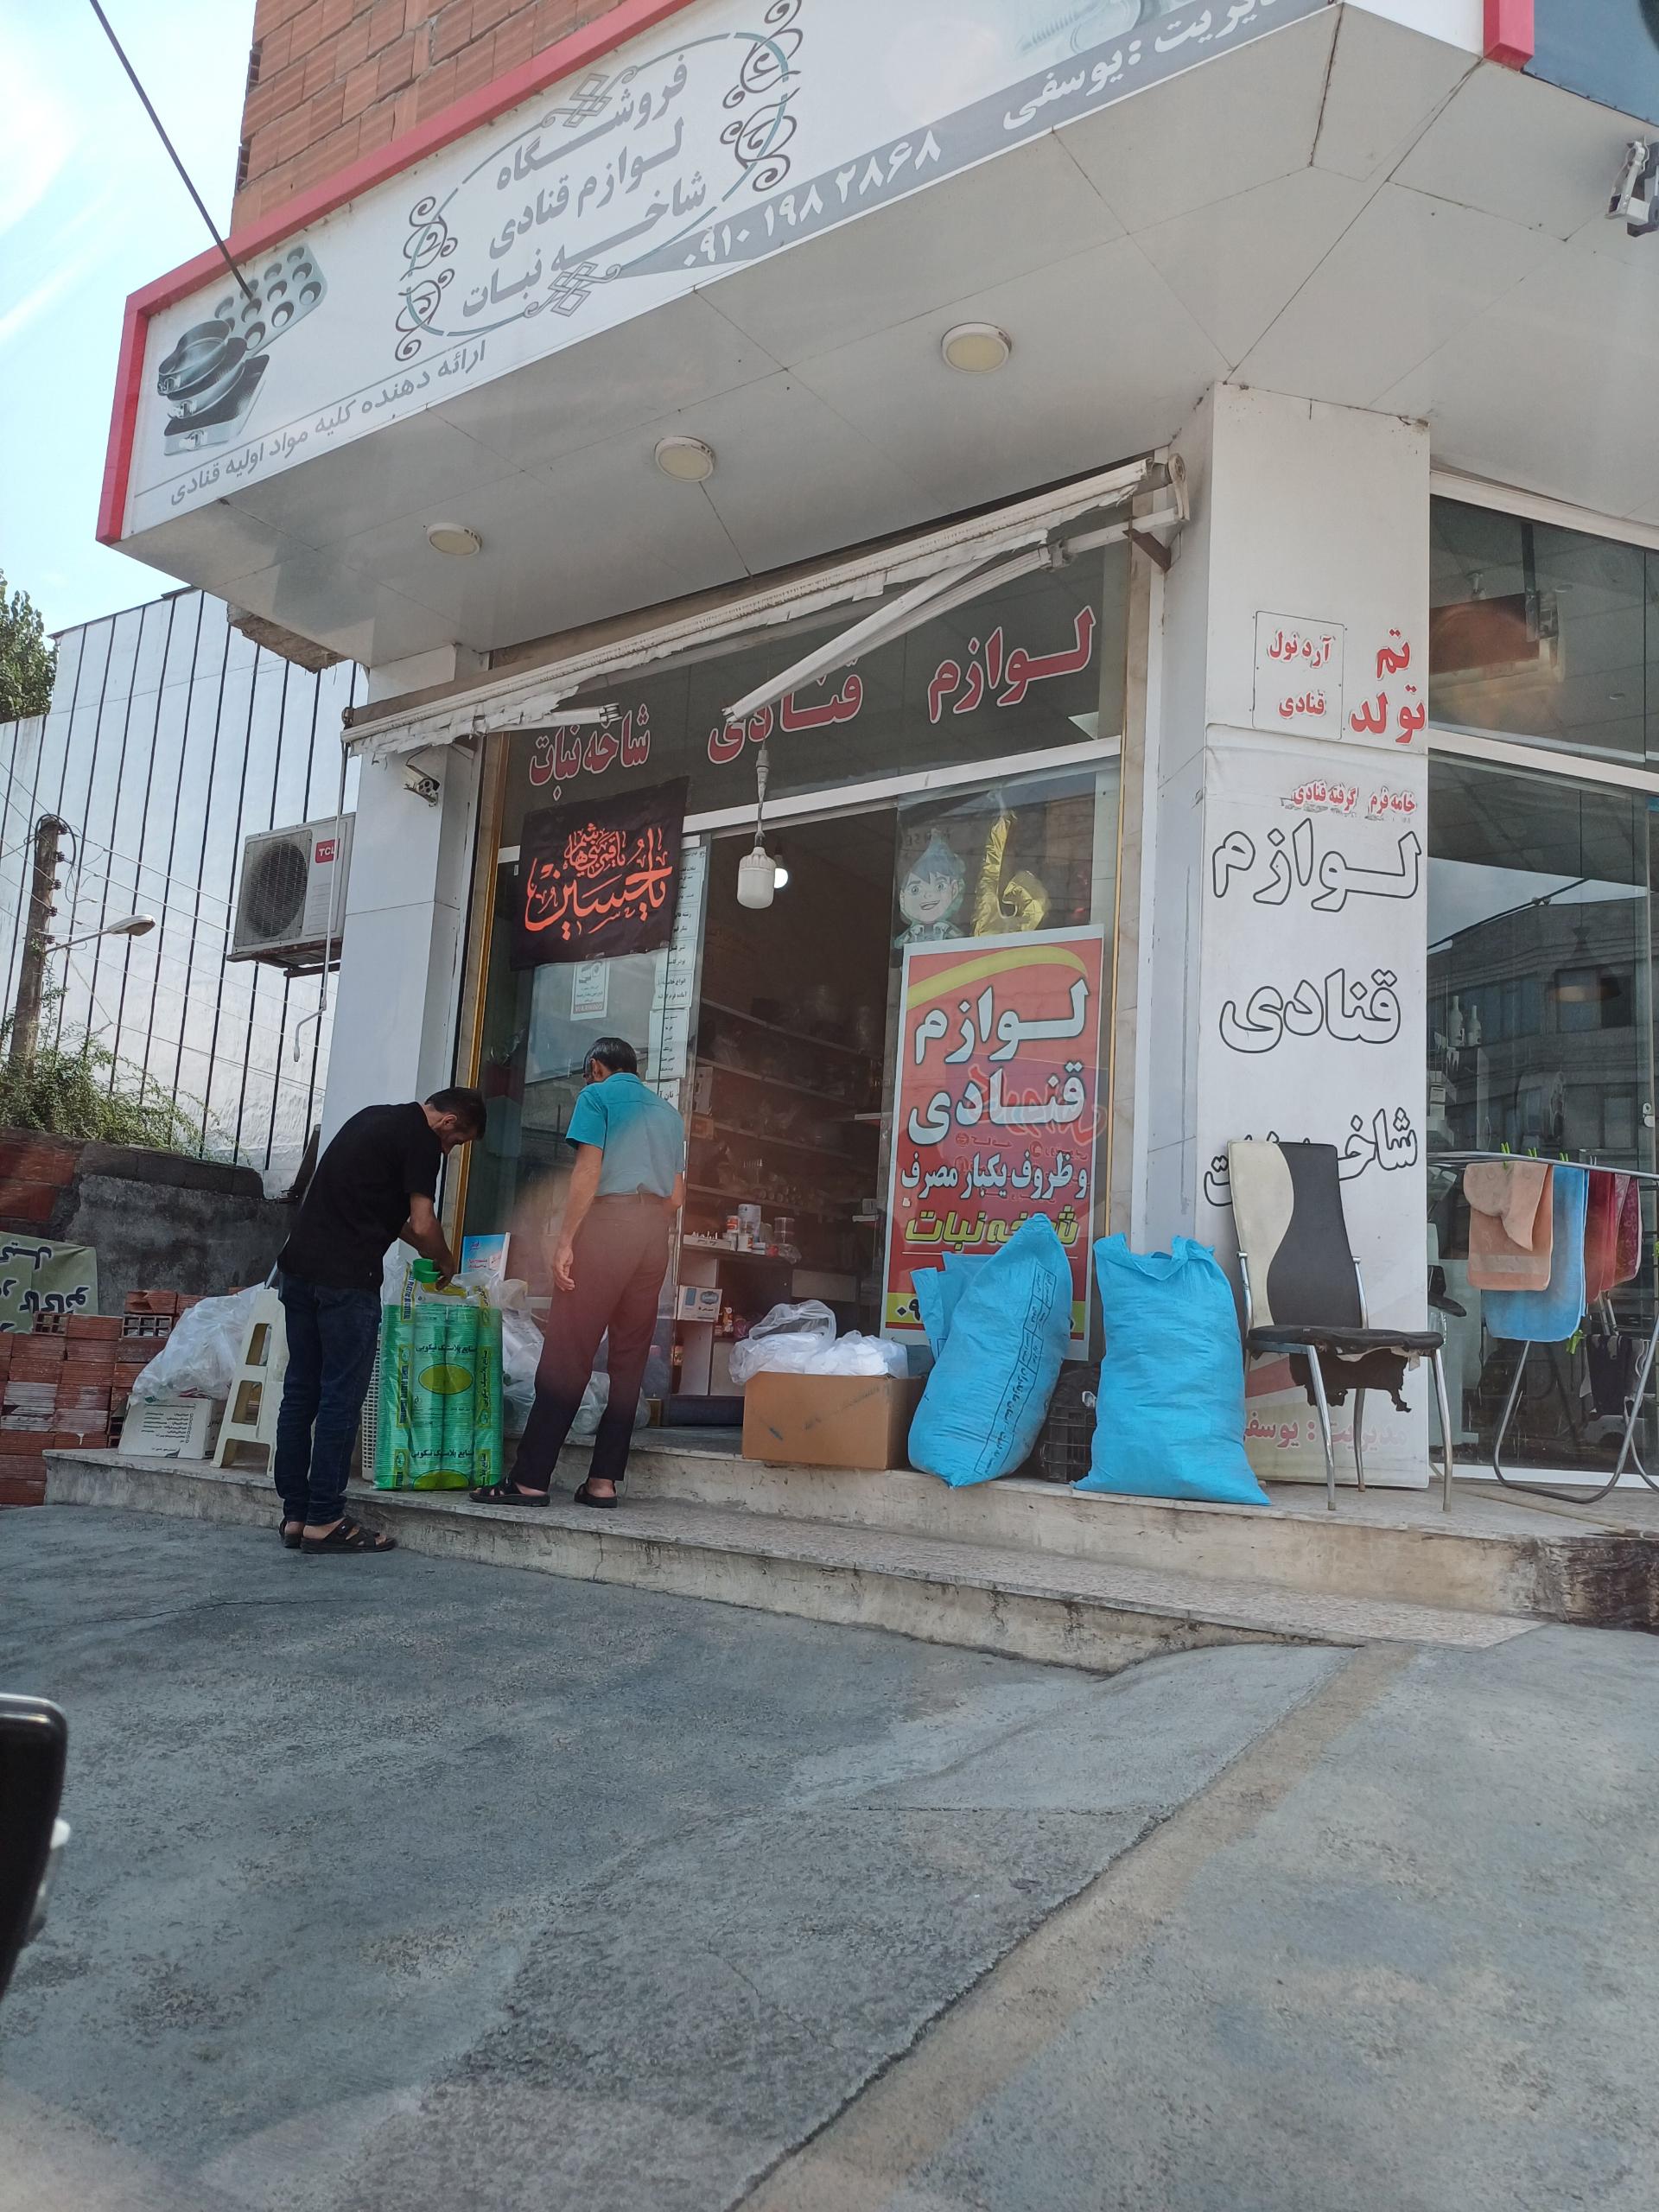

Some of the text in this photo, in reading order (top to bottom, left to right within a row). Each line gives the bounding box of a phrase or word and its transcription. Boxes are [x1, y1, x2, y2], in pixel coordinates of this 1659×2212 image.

[1155, 0, 1278, 53] یریت
[497, 54, 687, 190] فروشگاه
[489, 117, 684, 259] لوازم قنادی
[764, 184, 823, 237] ۱۹۸
[462, 171, 706, 316] شاخه نبات
[171, 340, 486, 505] ارائه دهنده کلیه مواد اولیه قنادی
[928, 606, 1096, 724] لوازم
[1376, 628, 1410, 679] تم
[1279, 691, 1325, 717] قنادی
[1350, 683, 1426, 744] تولد
[530, 703, 650, 801] شاخه نبات
[1212, 817, 1421, 912] لوازم
[915, 978, 1090, 1065] لوازم
[1219, 969, 1402, 1053] قنادی
[908, 1060, 1085, 1146] قنادی
[901, 1153, 958, 1199] مصرف
[960, 1153, 1007, 1199] یکبار
[1011, 1150, 1074, 1199] ظروف
[1075, 1167, 1089, 1199] و
[905, 1205, 1079, 1251] شخه نبات
[1244, 1410, 1300, 1449] یوسف
